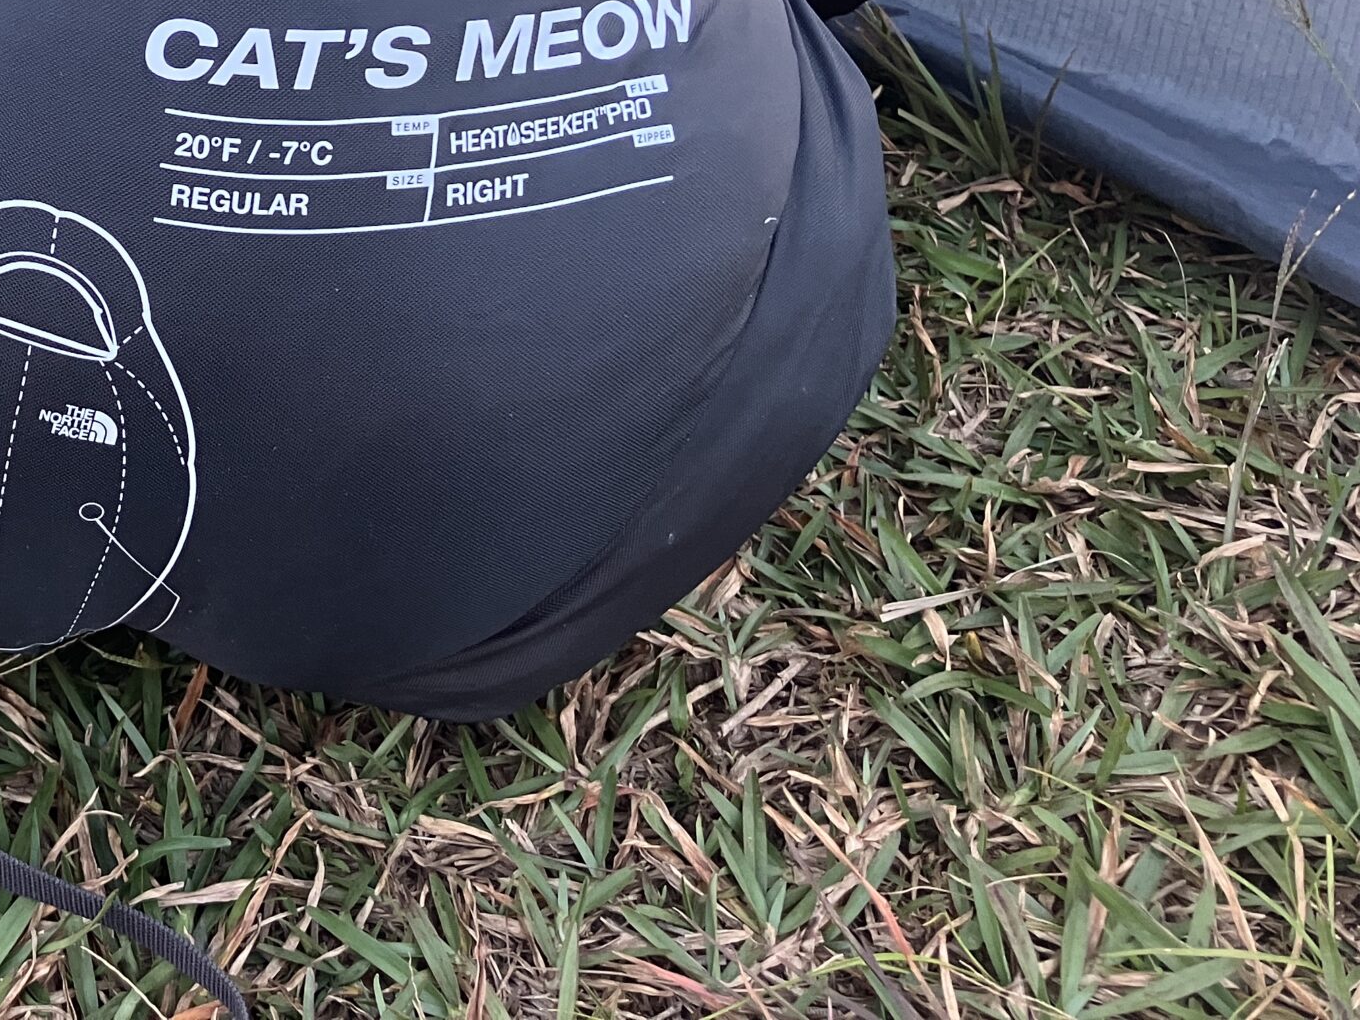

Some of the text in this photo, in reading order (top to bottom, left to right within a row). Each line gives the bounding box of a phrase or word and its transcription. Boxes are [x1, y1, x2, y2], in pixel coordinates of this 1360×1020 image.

[144, 18, 432, 90] CAT'S
[630, 80, 659, 94] FILL
[394, 120, 431, 132] TEMP
[637, 131, 673, 144] ZIPPER
[173, 132, 334, 166] 20°F / -7°C
[392, 174, 425, 186] SIZE
[446, 173, 530, 207] RIGHT
[170, 184, 310, 216] REGULAR
[38, 409, 93, 431] NORTH
[66, 404, 95, 420] THE
[51, 423, 89, 441] FACE
